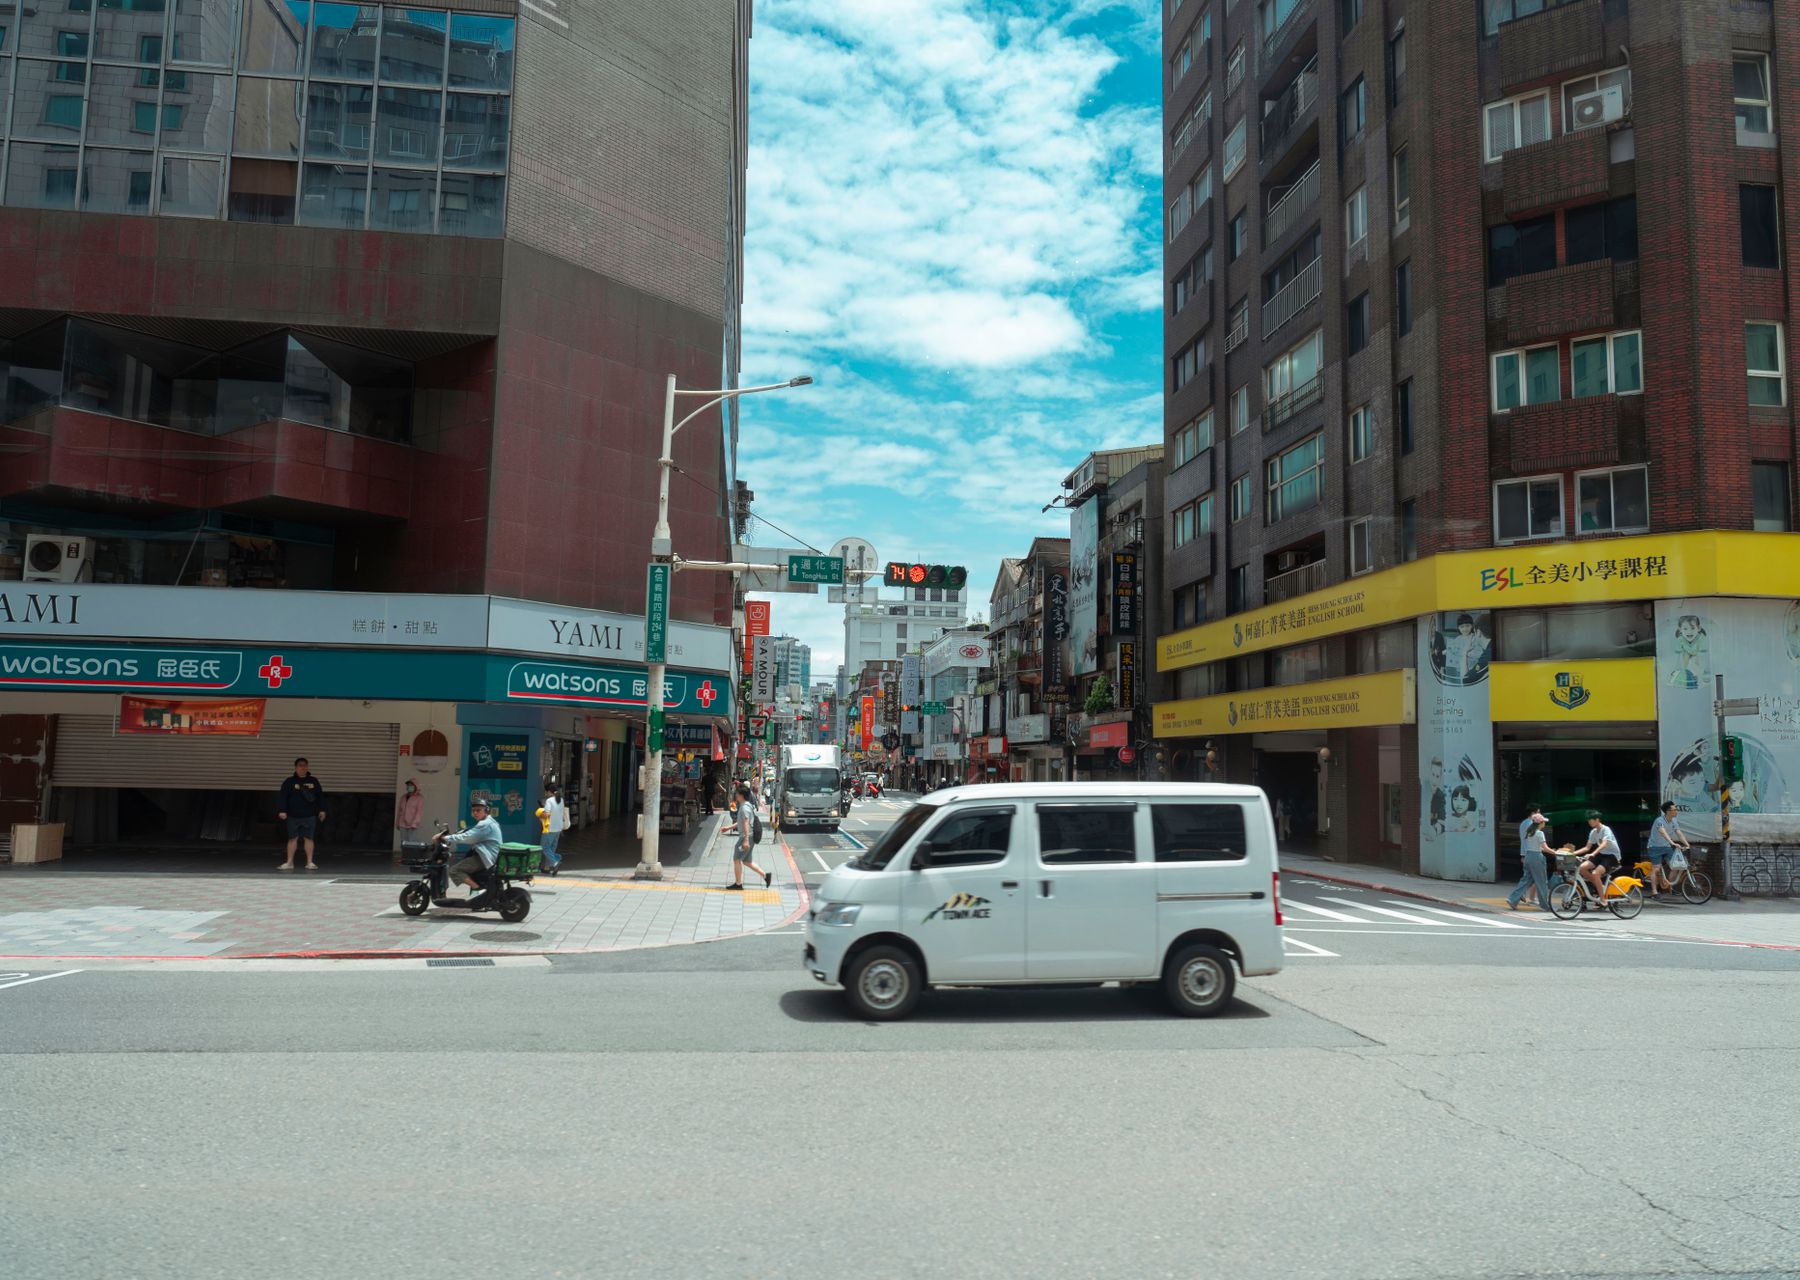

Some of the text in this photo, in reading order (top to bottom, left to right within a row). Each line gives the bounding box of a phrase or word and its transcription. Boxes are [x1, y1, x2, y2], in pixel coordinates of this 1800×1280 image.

[800, 558, 841, 571] 通化街
[890, 563, 905, 580] 74
[1480, 555, 1669, 592] ESL 全美小學課程
[802, 571, 828, 581] TongHua
[1307, 605, 1320, 614] HESS
[1320, 600, 1337, 610] YOUNG
[1308, 603, 1365, 625] ENGLISH SCHOOL
[549, 619, 623, 650] YAMI
[1245, 608, 1306, 641] 何嘉仁菁英美語
[2, 654, 139, 677] watsons
[157, 658, 221, 679] 屈臣氏
[758, 646, 769, 696] A'MOUR
[524, 671, 620, 695] watsons
[632, 679, 673, 699] 屈氏
[1239, 697, 1300, 721] 何嘉仁菁英美語
[1302, 696, 1314, 705] HESS
[1314, 694, 1331, 704] YOUNG
[1302, 702, 1360, 717] ENGLISH SCHOOL
